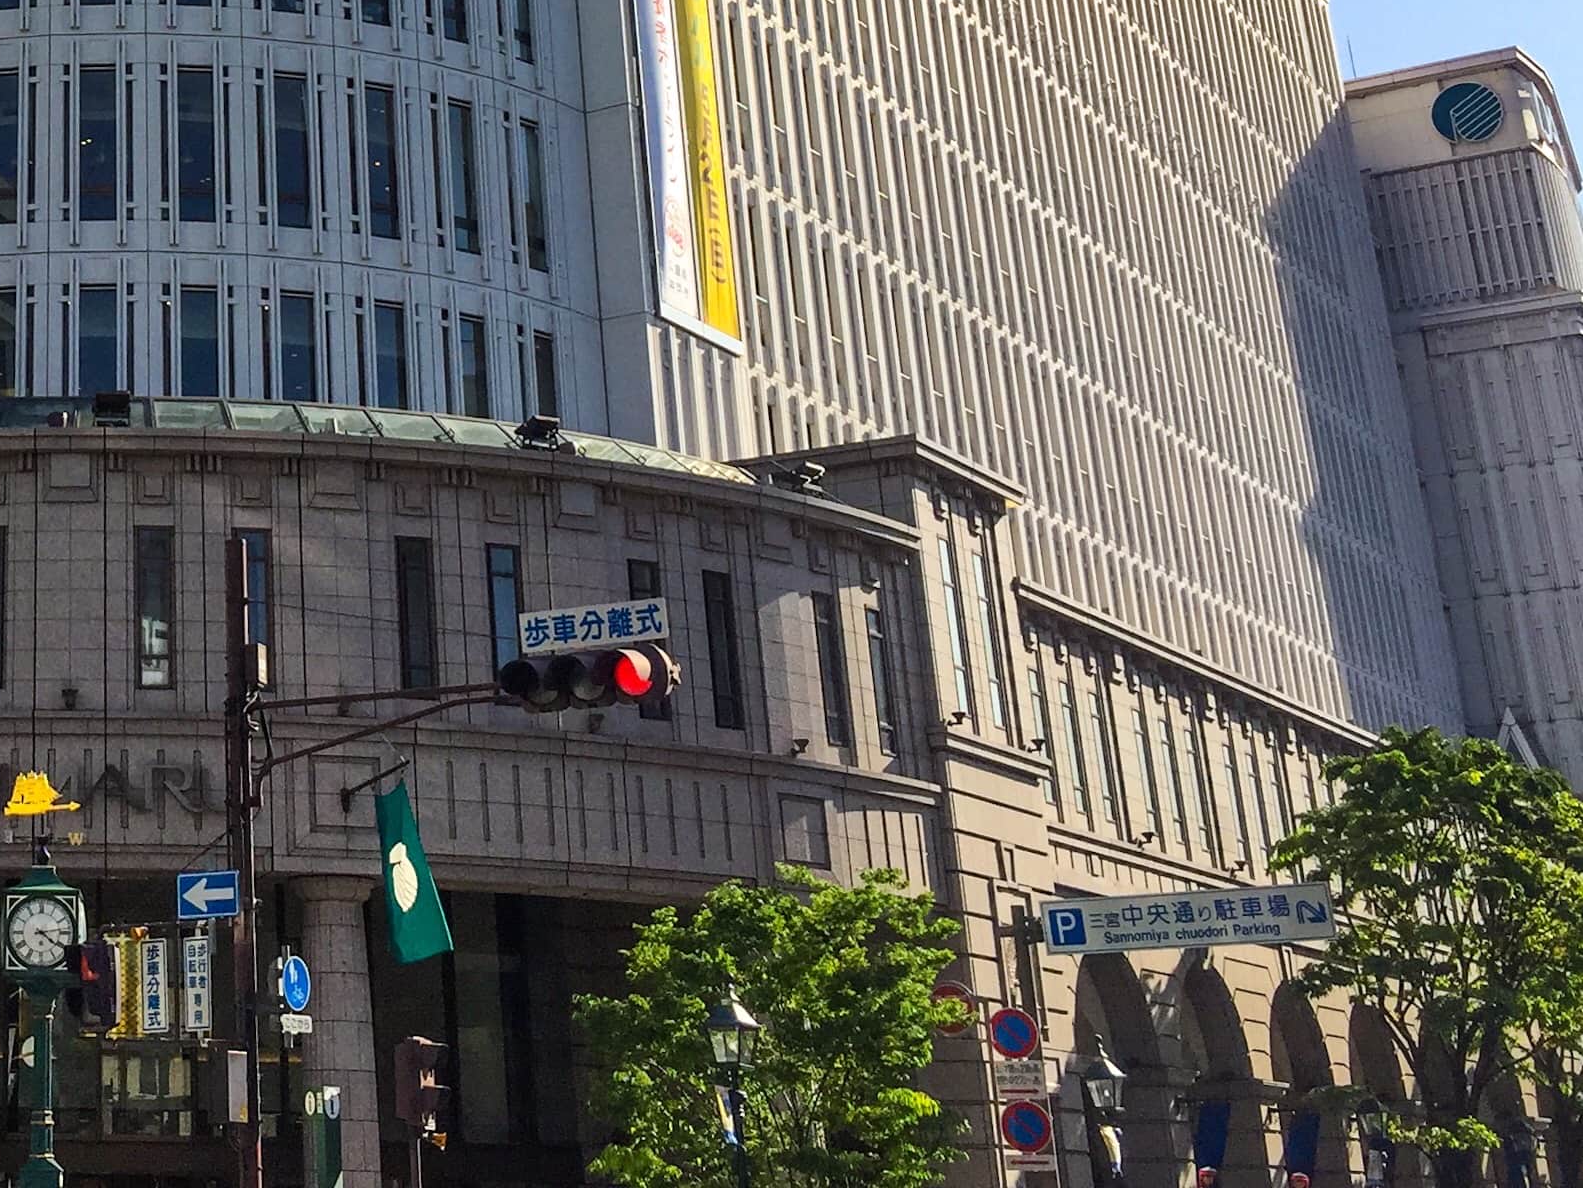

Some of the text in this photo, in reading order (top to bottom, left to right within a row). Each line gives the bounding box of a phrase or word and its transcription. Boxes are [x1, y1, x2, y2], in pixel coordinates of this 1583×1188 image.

[524, 603, 663, 648] 歩車分離式
[1105, 922, 1281, 945] Sannomiya chuodori Parking
[146, 945, 161, 1027] 歩車分離式
